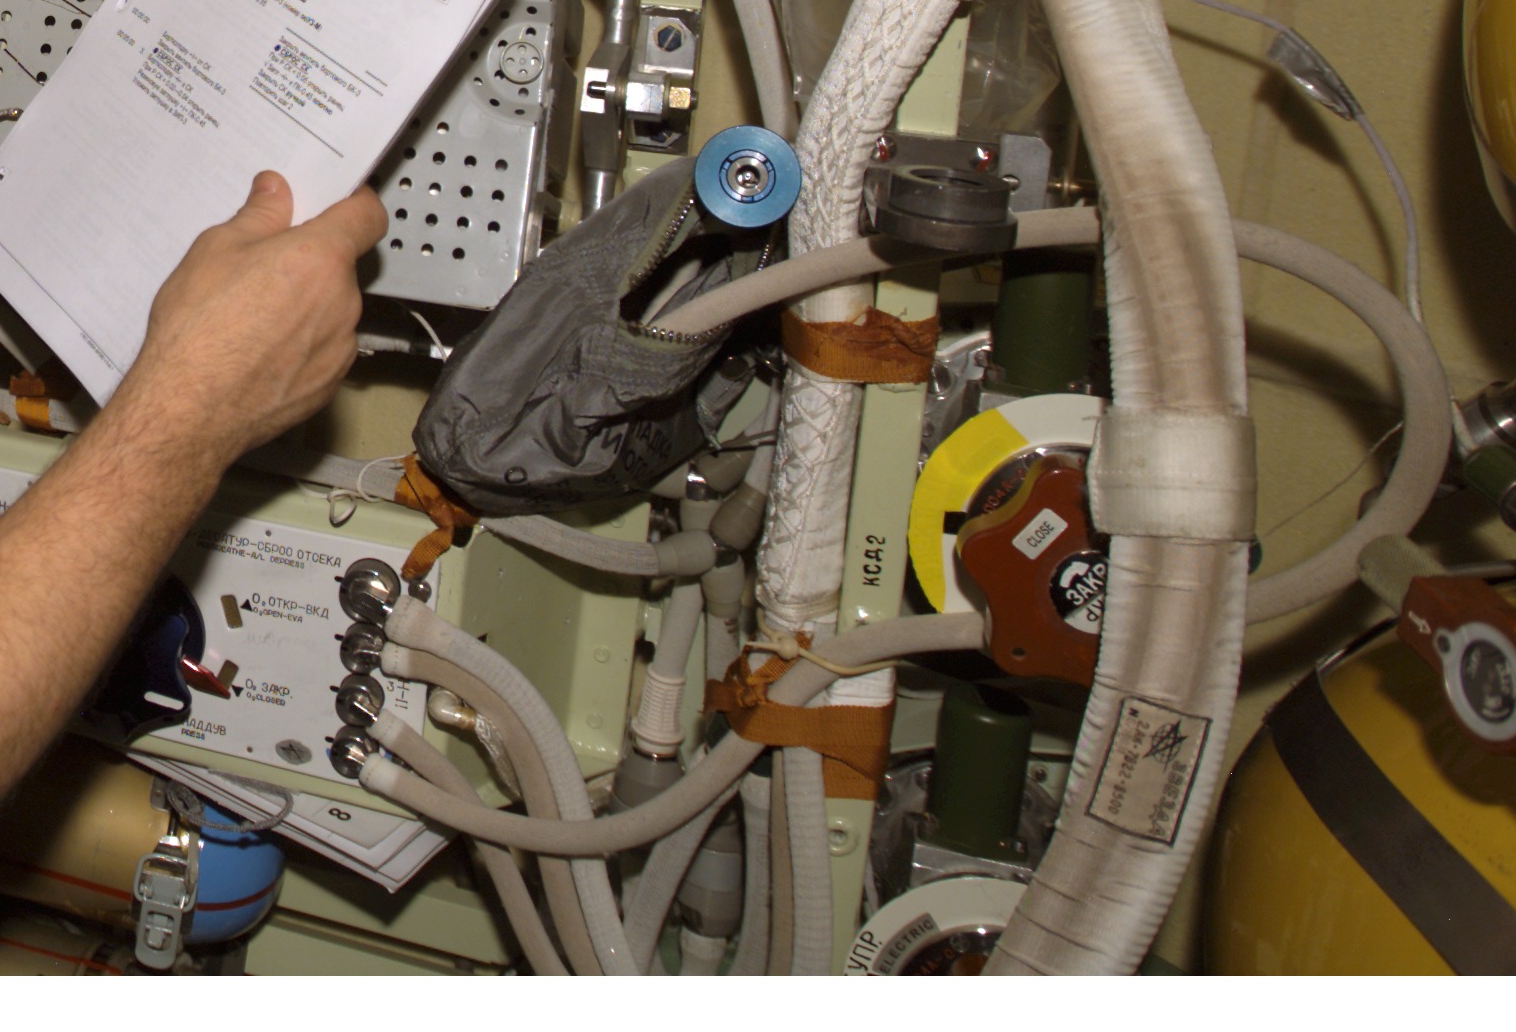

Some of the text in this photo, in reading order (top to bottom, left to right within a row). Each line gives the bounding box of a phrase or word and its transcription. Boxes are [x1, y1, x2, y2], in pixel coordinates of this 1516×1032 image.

[1026, 520, 1055, 549] CLOSE
[297, 549, 342, 568] ОТСЕКА
[861, 534, 886, 587] КСД2
[328, 807, 352, 822] 8
[879, 919, 935, 974] ELECTRIC
